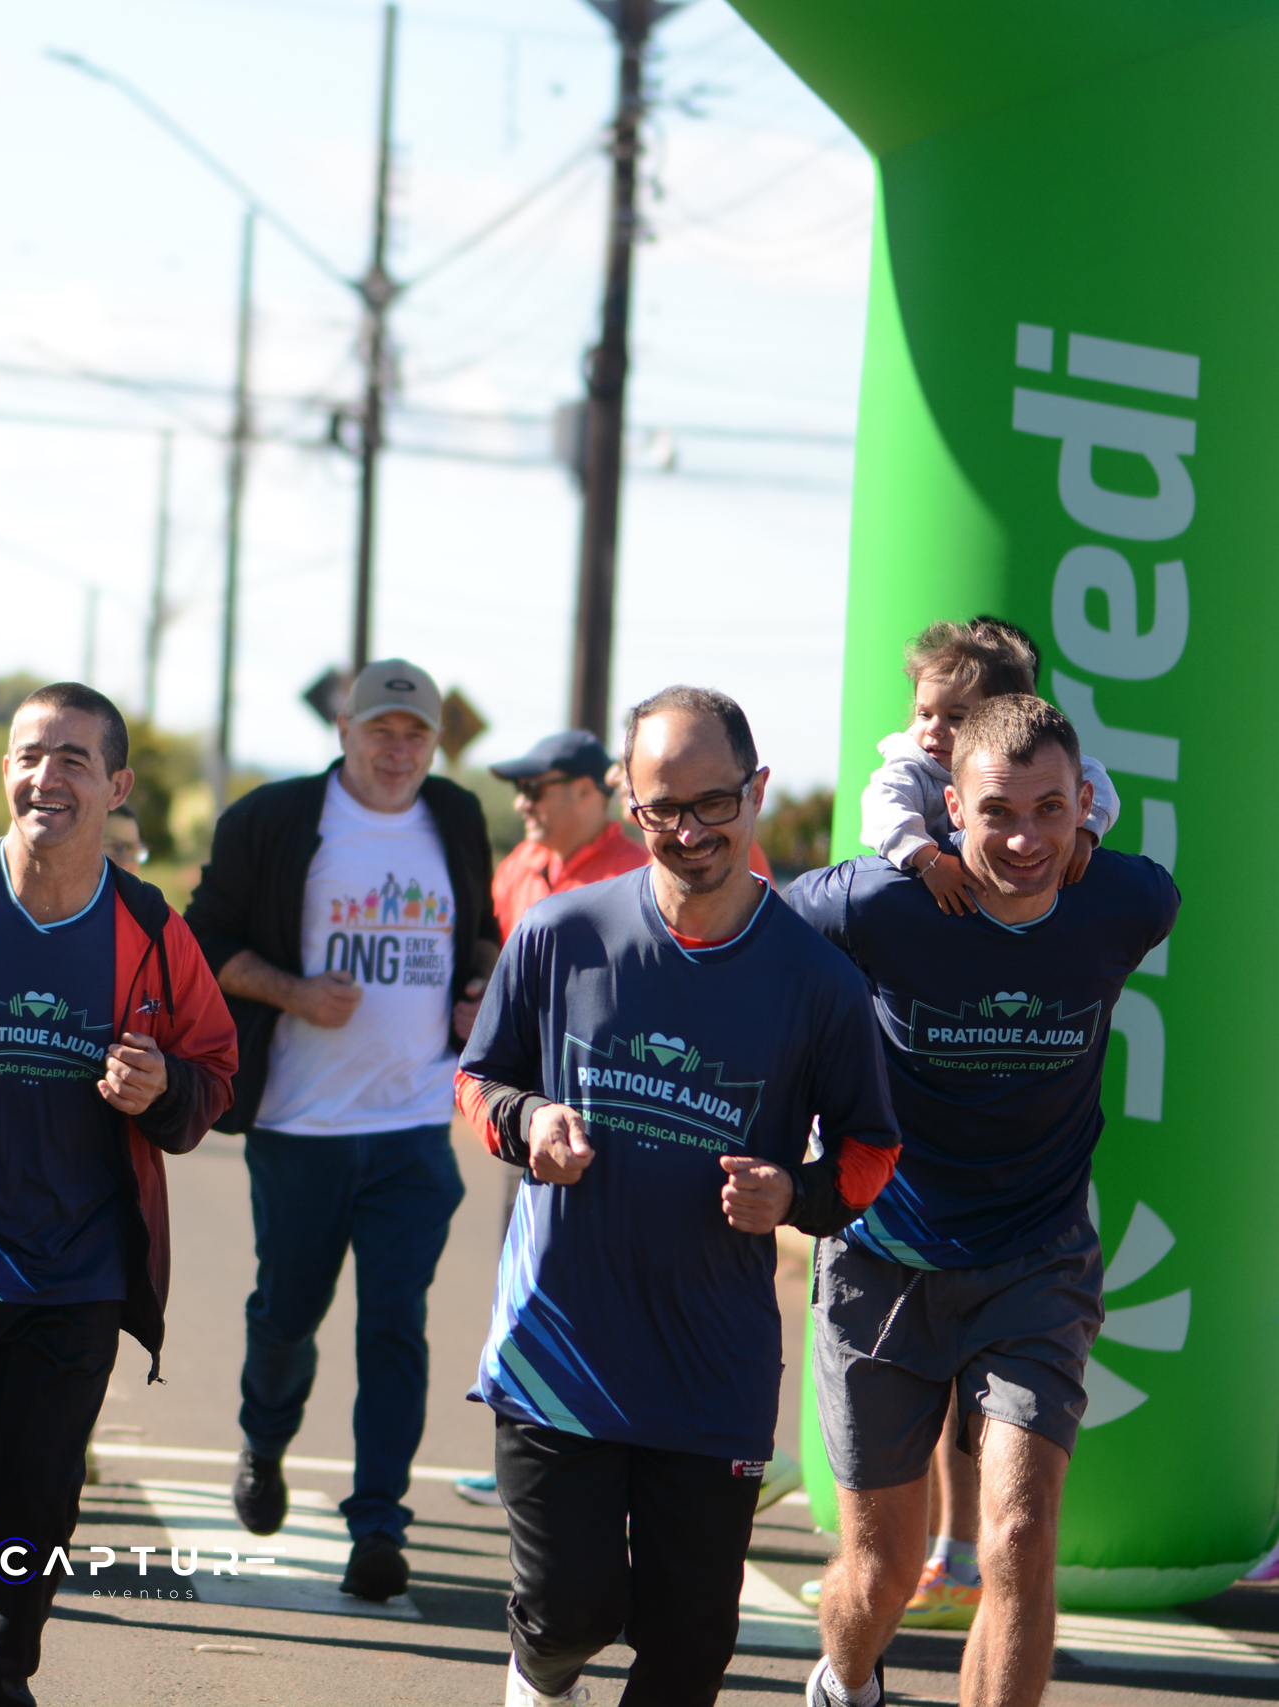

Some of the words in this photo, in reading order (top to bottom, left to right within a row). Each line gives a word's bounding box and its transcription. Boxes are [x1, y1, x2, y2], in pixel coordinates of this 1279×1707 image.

[325, 931, 400, 985] ONG
[50, 1032, 105, 1062] AJUDA
[927, 1027, 1023, 1044] PRATIQUE
[1025, 1029, 1084, 1046] AJUDA
[67, 1068, 92, 1081] AÇÃO
[928, 1057, 989, 1072] EDUCAÇÃO
[991, 1060, 1027, 1070] FÍSICA
[1029, 1062, 1046, 1071] EM
[577, 1066, 676, 1101] PRATIQUE
[676, 1087, 742, 1127] AJUDA
[637, 1122, 677, 1142] FÍSICA
[679, 1133, 697, 1147] EM
[699, 1138, 729, 1154] AÇÃO
